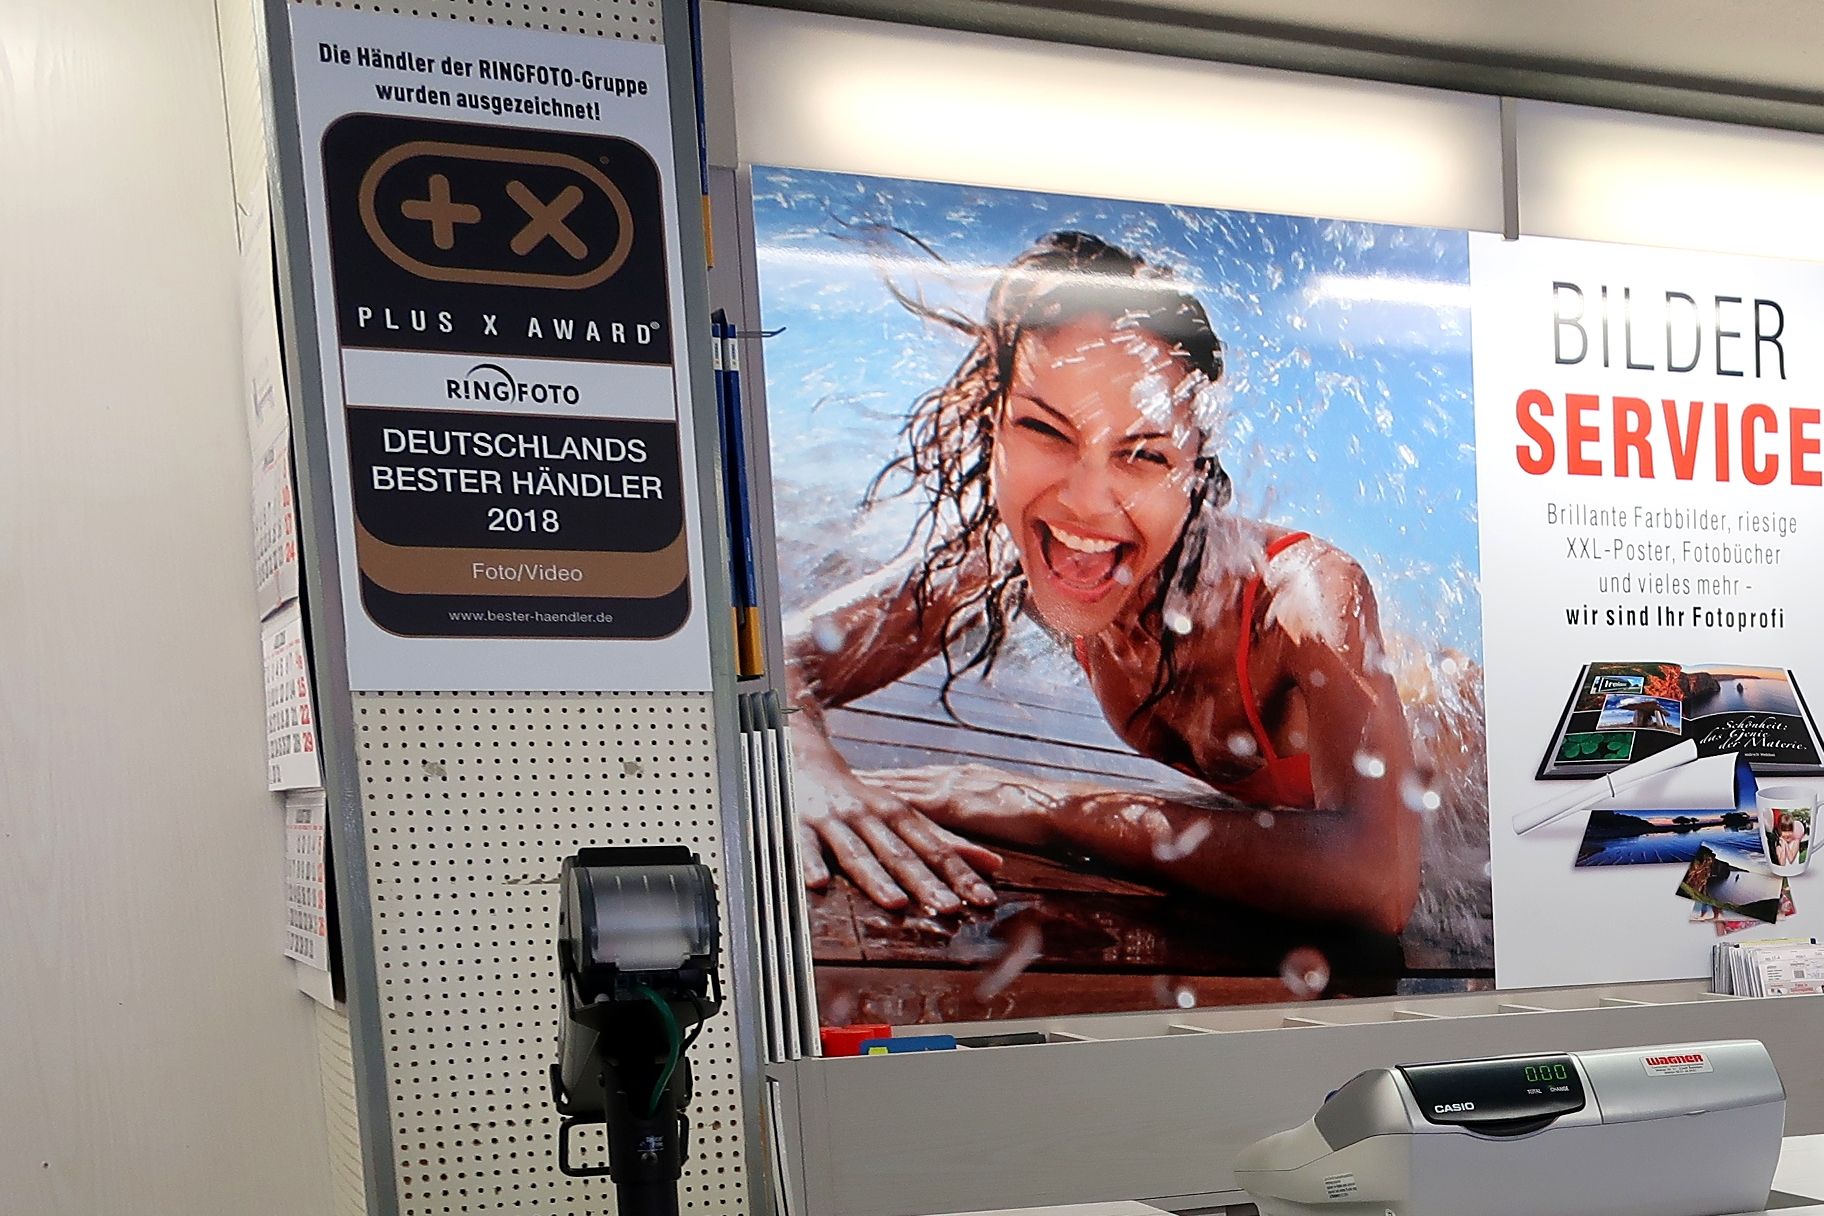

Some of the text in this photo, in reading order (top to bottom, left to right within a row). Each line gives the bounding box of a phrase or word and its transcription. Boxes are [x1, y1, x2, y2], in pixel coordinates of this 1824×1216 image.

[319, 42, 648, 97] Die Händler der RINGFOTO-Gruppe
[376, 84, 601, 120] wurden ausgezeichnet!
[358, 306, 453, 333] PLUS
[483, 314, 498, 336] X
[1552, 280, 1787, 380] BILDER
[383, 428, 647, 463] DEUTSCHLANDS
[1515, 388, 1823, 487] SERVICE
[372, 466, 663, 500] BESTER HÄNDLER
[487, 508, 560, 533] 2018
[1547, 502, 1797, 537] Brillante Farbbilder, riesige
[1566, 536, 1781, 565] XXL-Poster, Fotobücher
[472, 562, 583, 582] Foto/Video
[1599, 572, 1631, 593] und
[1638, 573, 1690, 595] vieles
[1697, 575, 1739, 596] mehr
[449, 609, 613, 624] www.bester-haendler.de
[1566, 604, 1785, 632] wir sind Ihr Fotoprofi
[1434, 1101, 1475, 1114] CASIO
